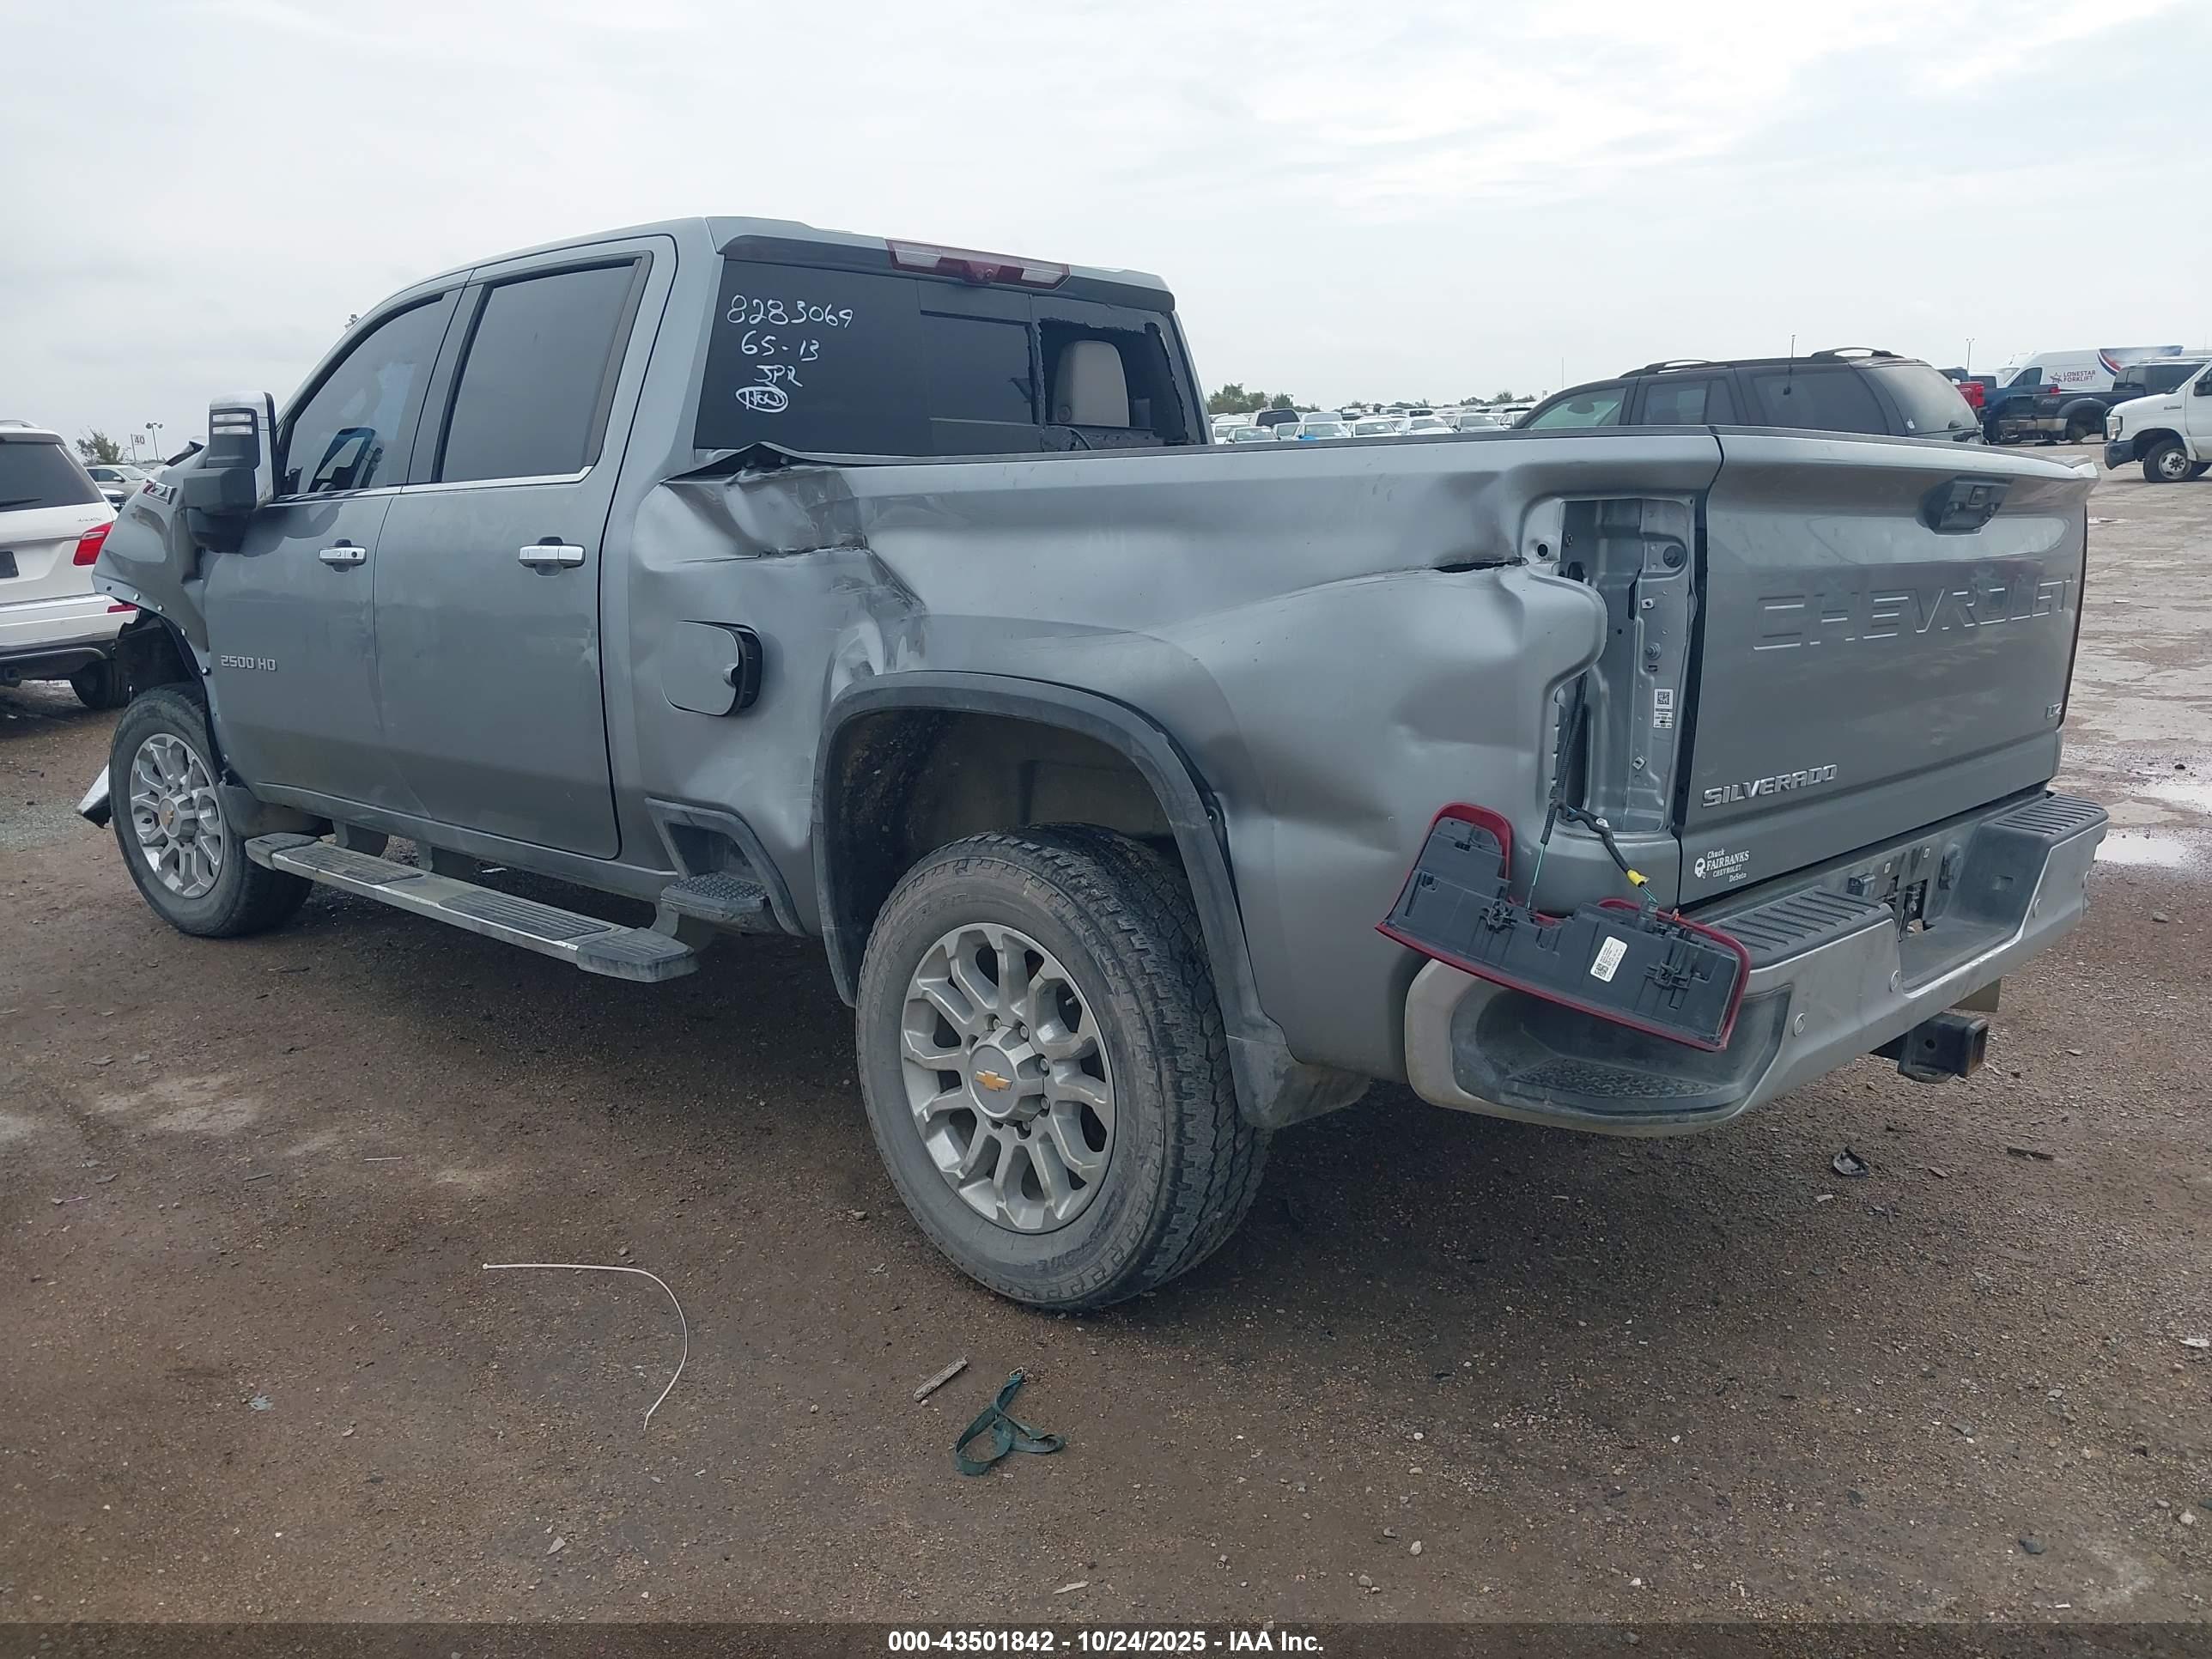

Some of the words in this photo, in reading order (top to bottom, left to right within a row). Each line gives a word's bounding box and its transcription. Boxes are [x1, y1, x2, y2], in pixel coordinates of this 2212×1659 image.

[134, 434, 145, 445] 40
[1753, 574, 2076, 651] CHEVROLET
[221, 654, 255, 669] 2500
[258, 658, 276, 671] HD
[1702, 764, 1838, 808] SILVERADO
[1706, 850, 1750, 872] FAIRBANKS
[1707, 848, 1725, 860] Chuck
[1712, 864, 1742, 878] CHEVROLET
